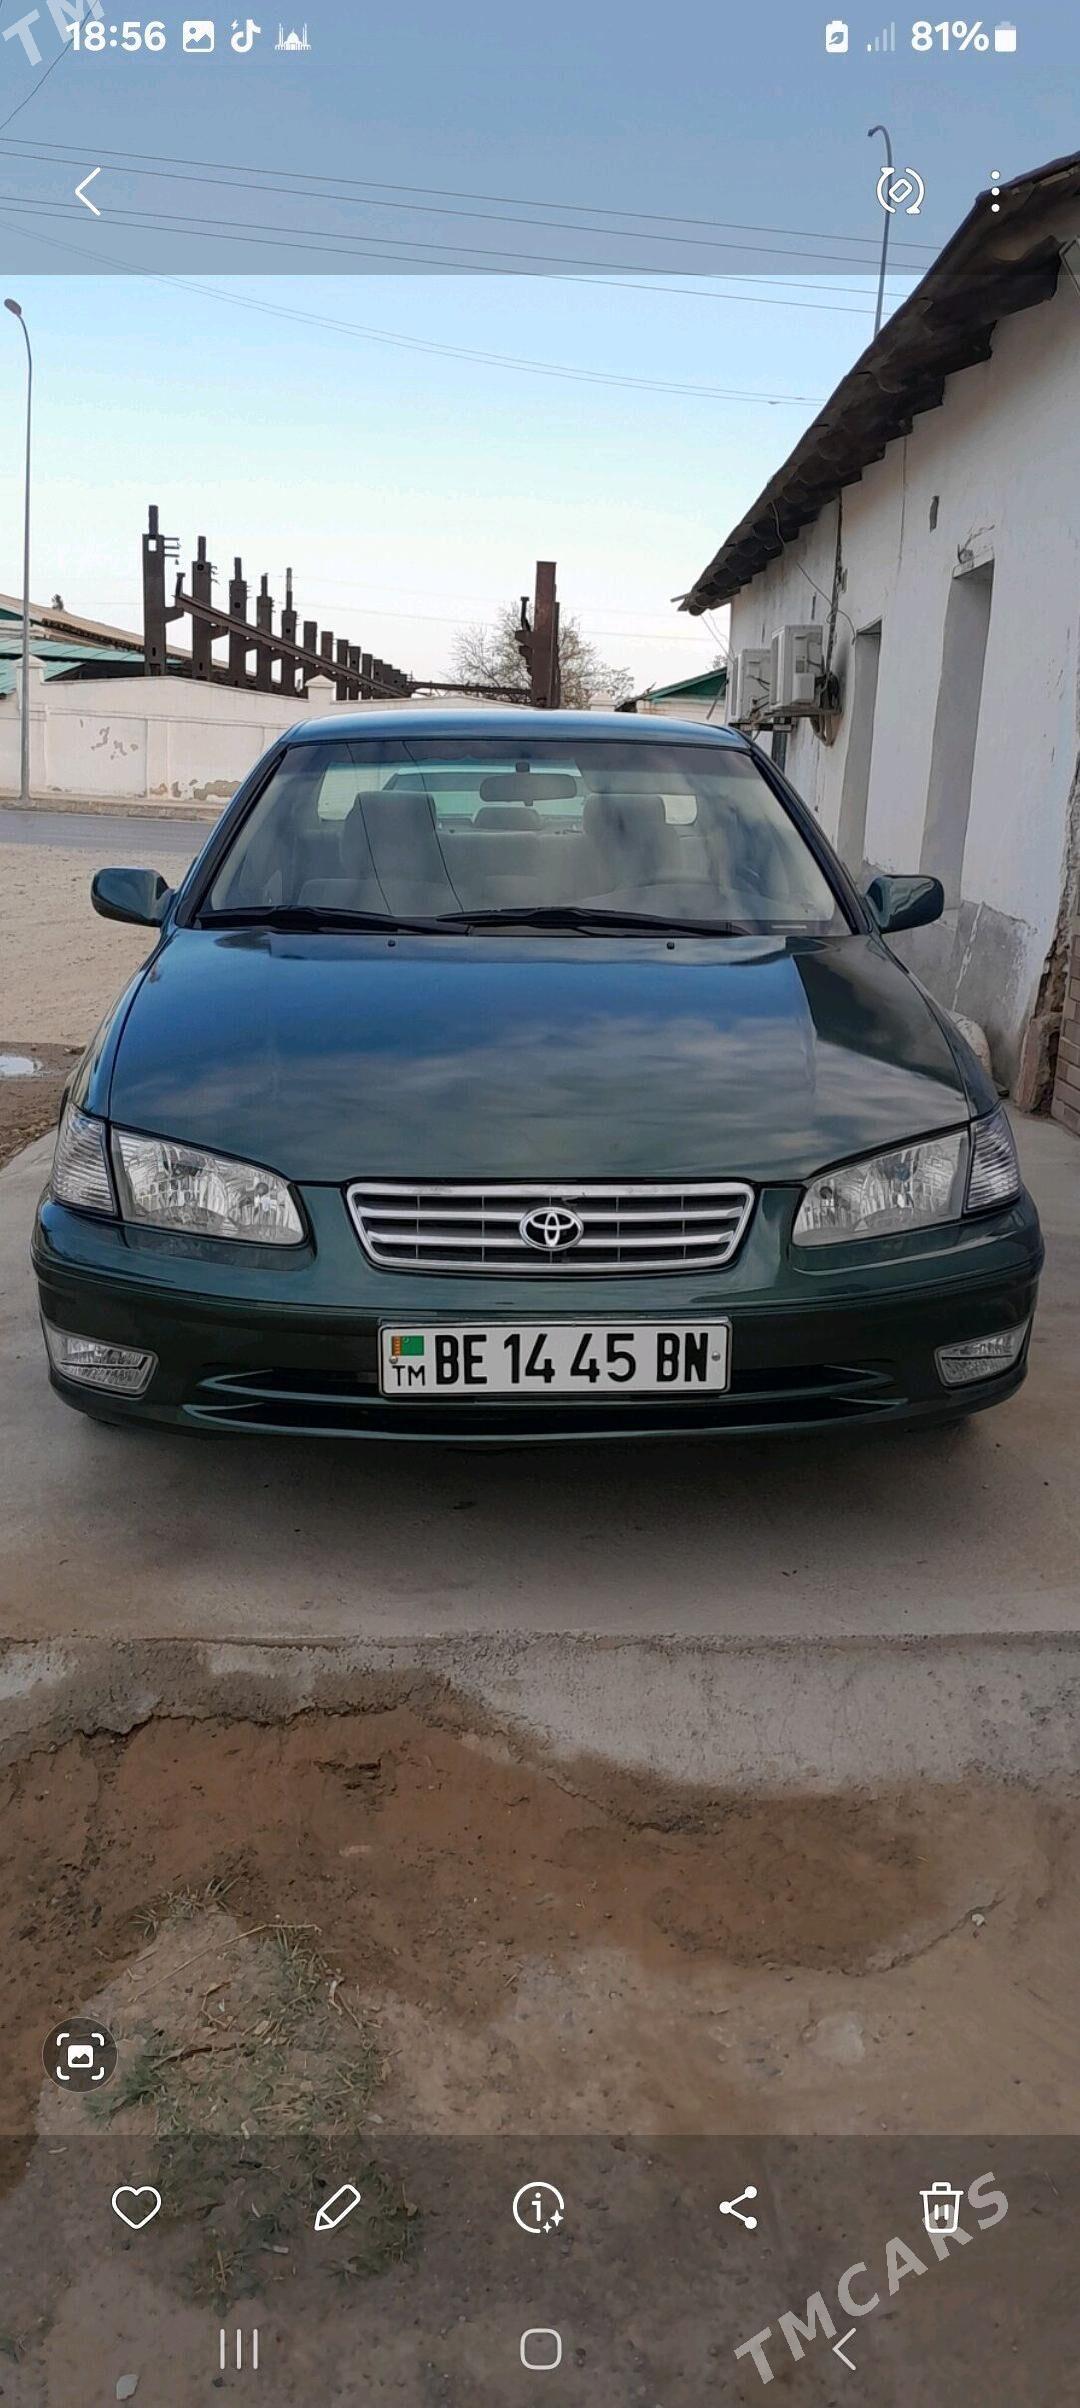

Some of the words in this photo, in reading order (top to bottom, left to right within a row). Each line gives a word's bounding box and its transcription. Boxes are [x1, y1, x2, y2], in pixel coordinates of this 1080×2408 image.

[392, 1365, 426, 1387] TM
[435, 1333, 488, 1385] BE
[504, 1333, 556, 1384] 14
[570, 1332, 637, 1383] 45
[656, 1331, 709, 1382] BN
